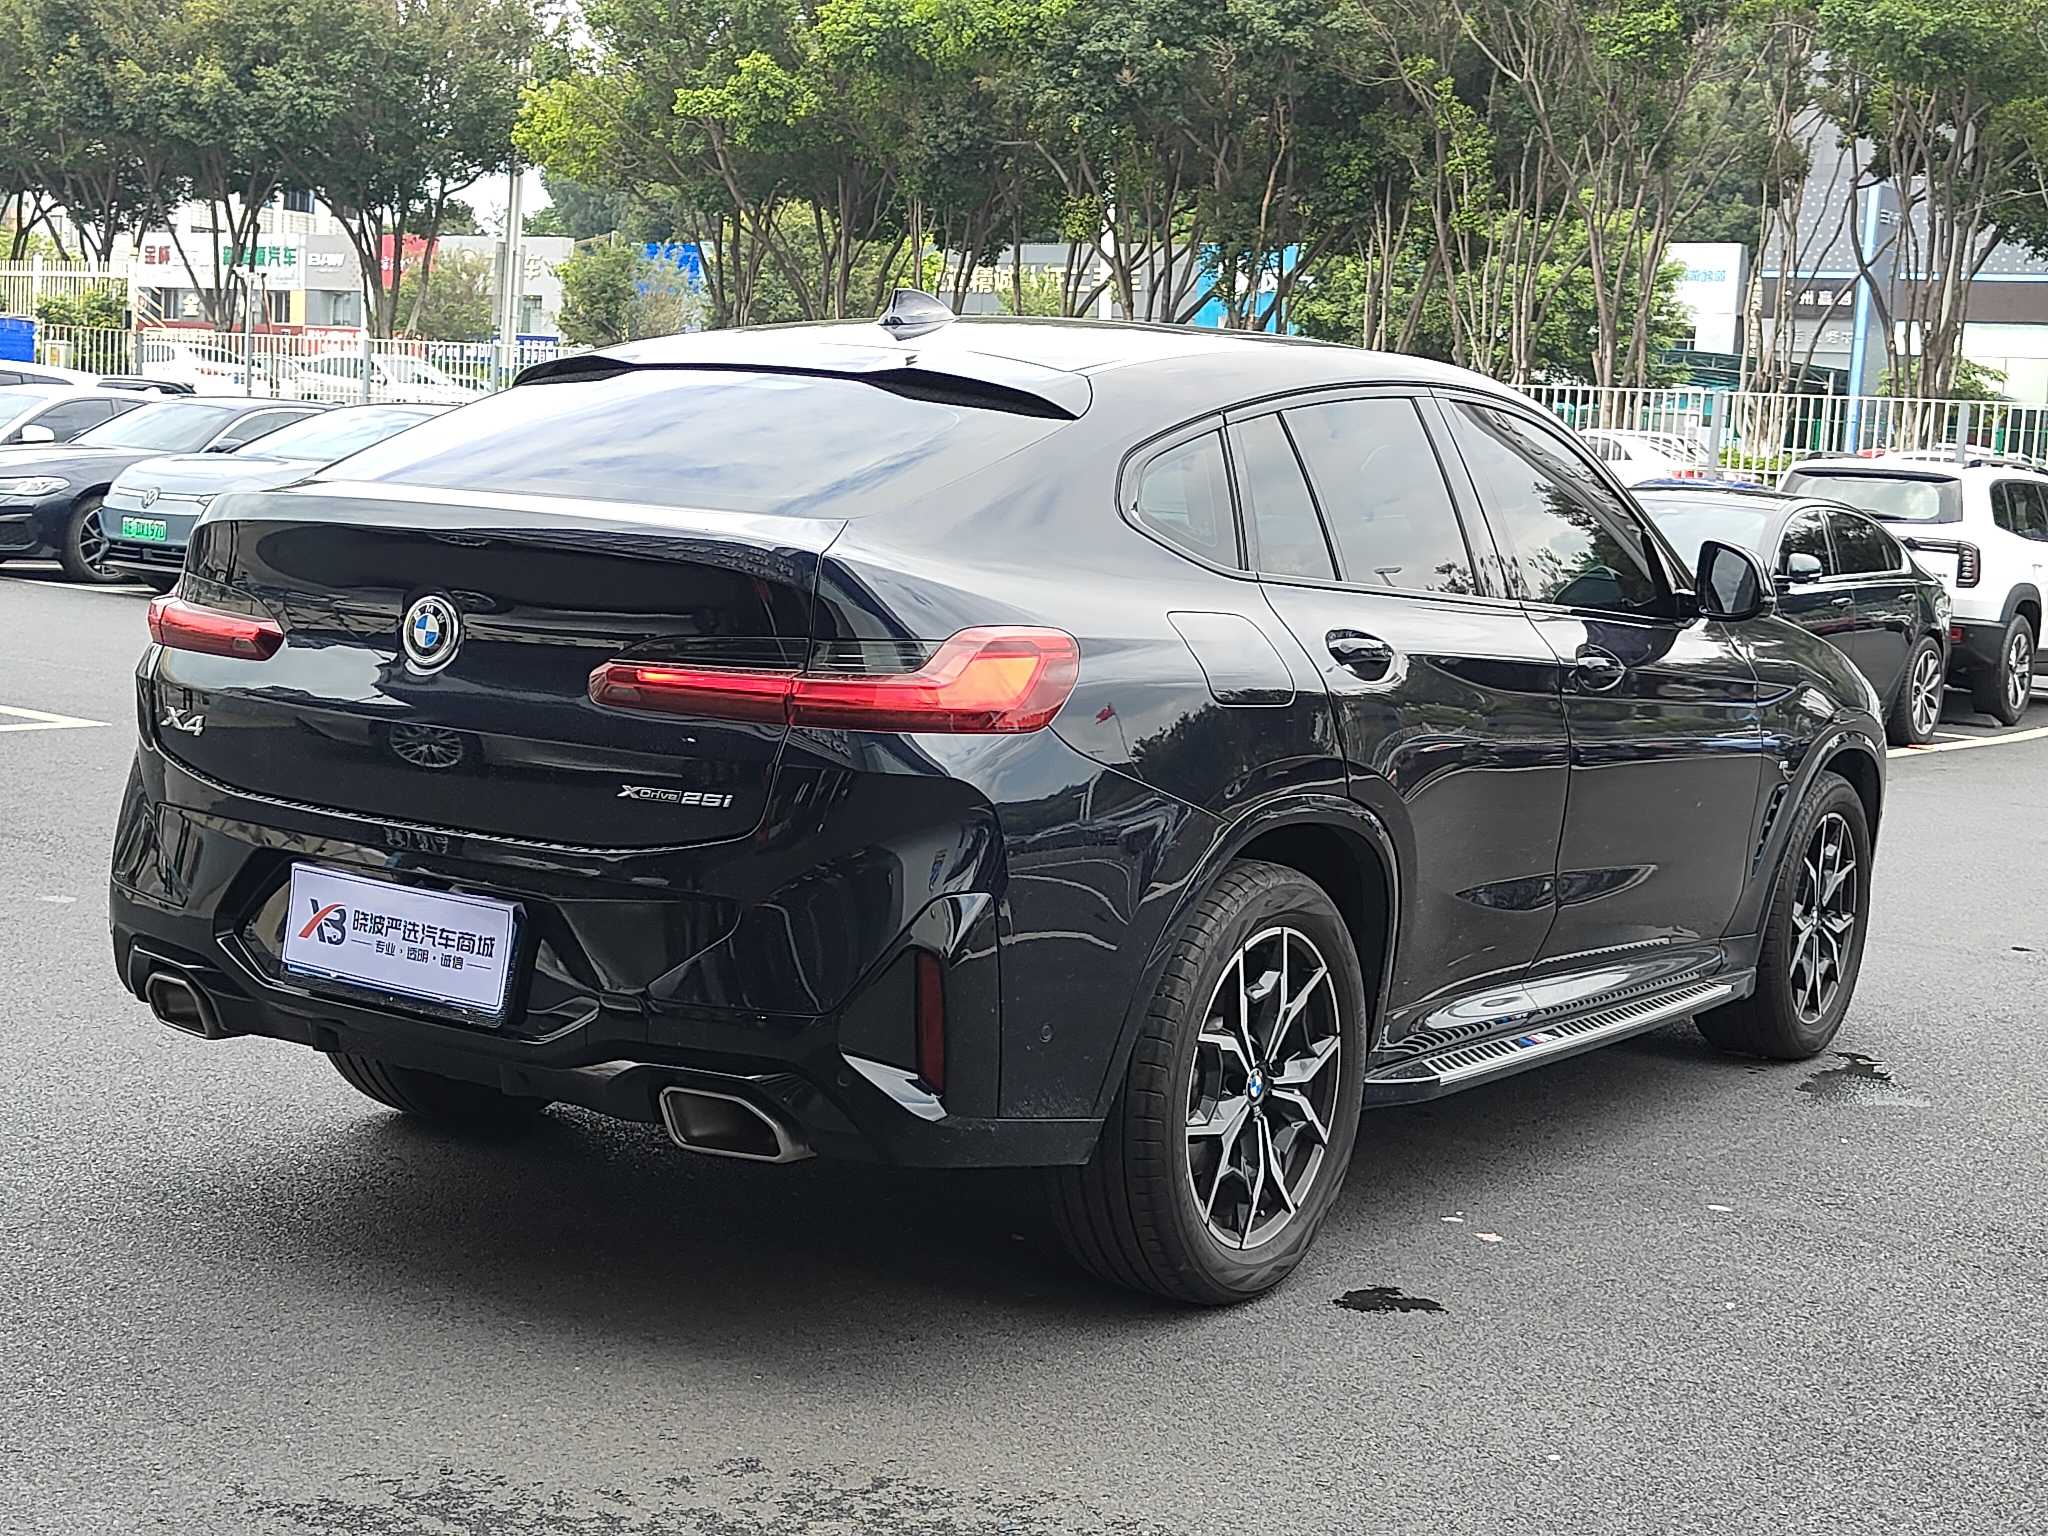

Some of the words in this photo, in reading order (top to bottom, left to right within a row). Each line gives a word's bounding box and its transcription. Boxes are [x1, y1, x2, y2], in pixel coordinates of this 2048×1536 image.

[160, 705, 206, 736] X4
[681, 791, 734, 808] 25i
[352, 909, 496, 959] 晓波严选汽车商城
